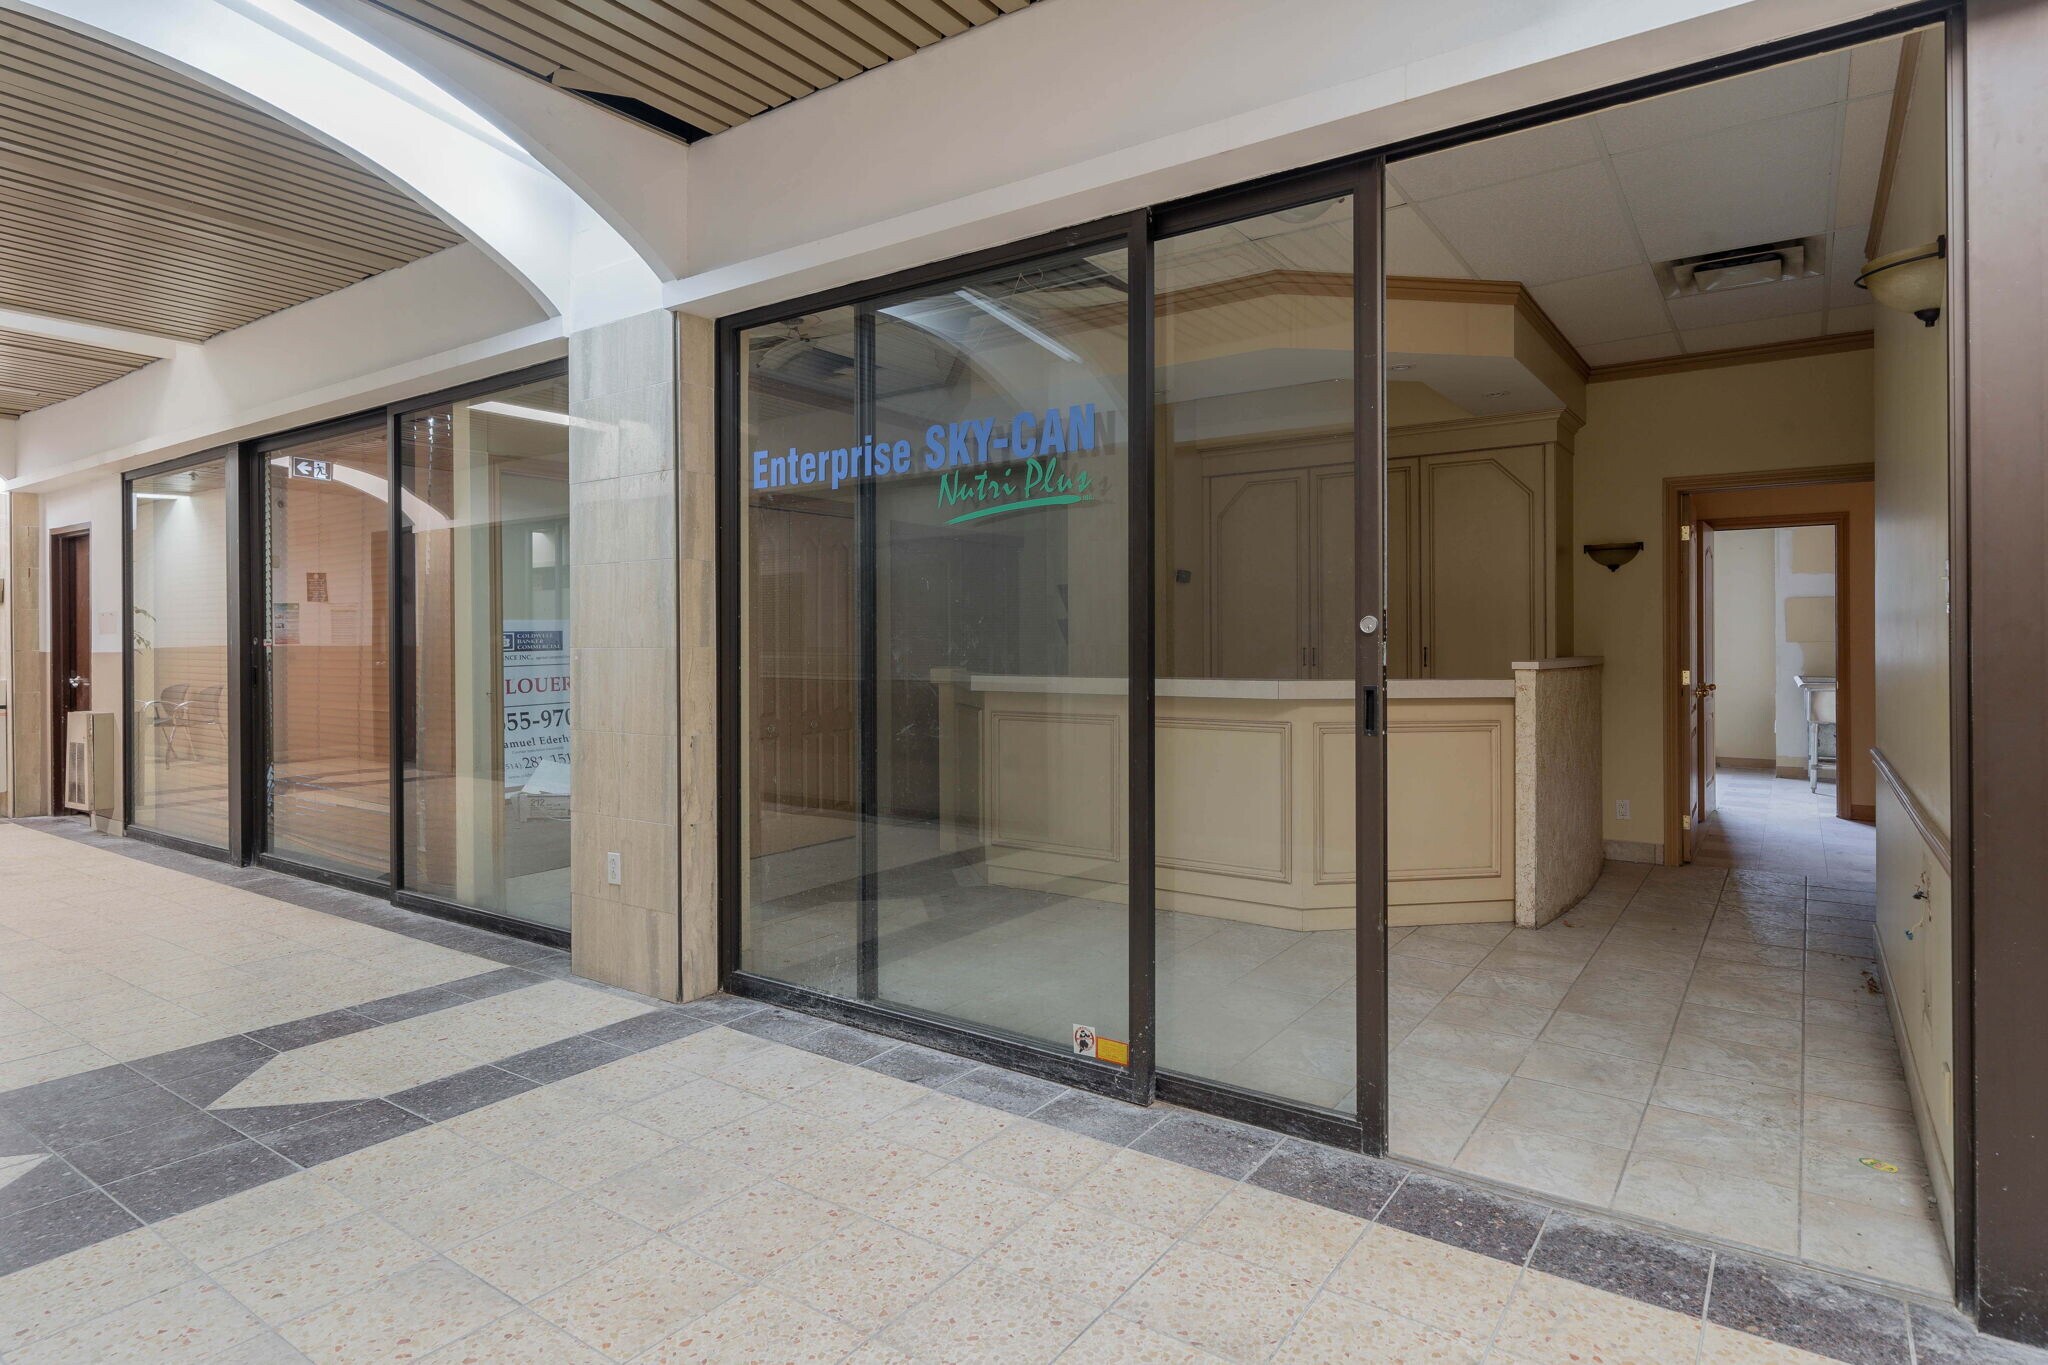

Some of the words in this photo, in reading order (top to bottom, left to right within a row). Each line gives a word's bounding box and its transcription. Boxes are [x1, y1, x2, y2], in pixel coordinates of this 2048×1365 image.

[752, 434, 912, 490] Enterprise
[925, 403, 1096, 470] SKY-CAN
[937, 467, 1017, 509] Nutri
[1024, 456, 1093, 499] Plus
